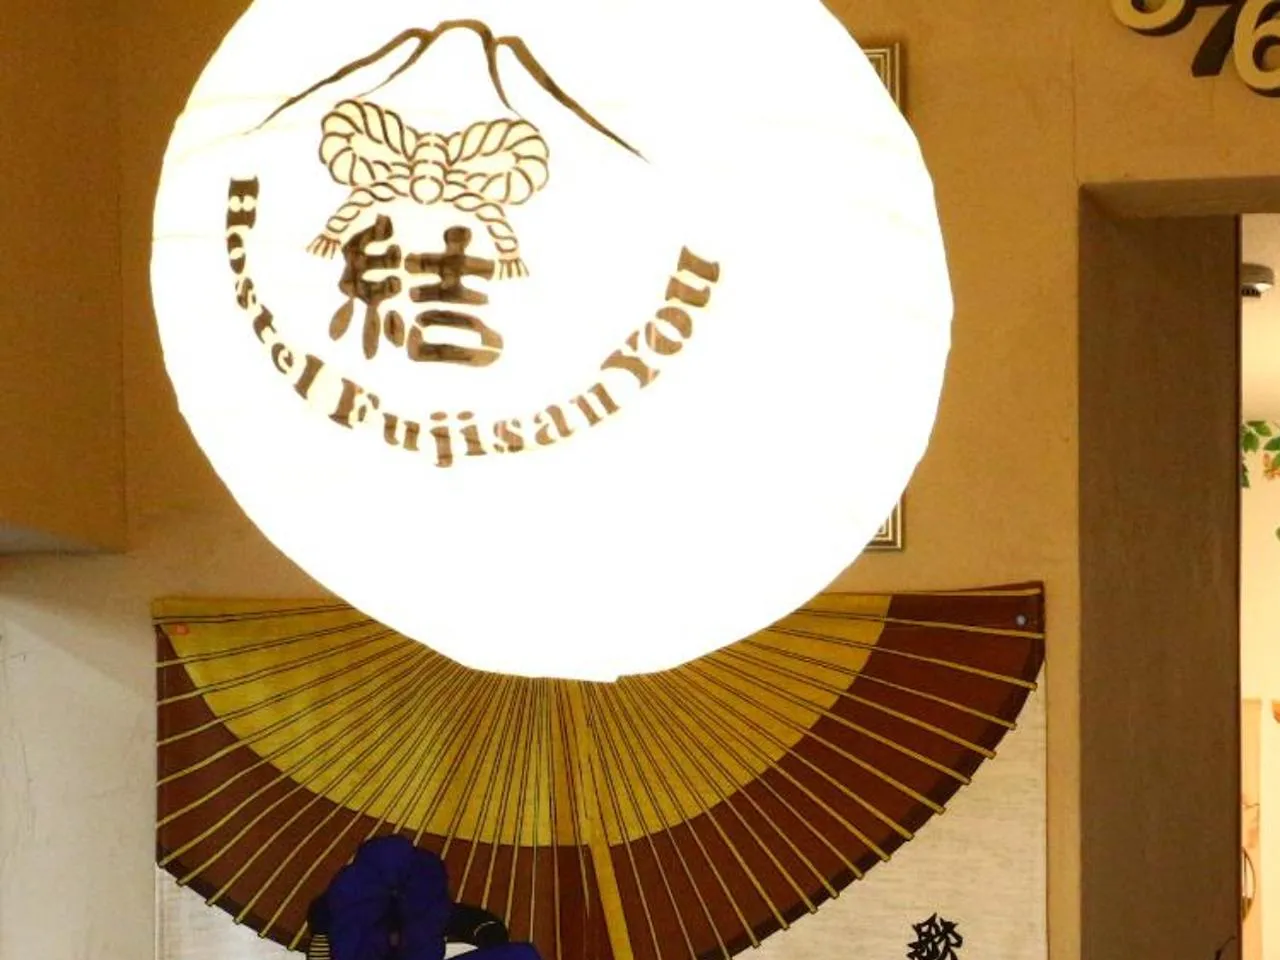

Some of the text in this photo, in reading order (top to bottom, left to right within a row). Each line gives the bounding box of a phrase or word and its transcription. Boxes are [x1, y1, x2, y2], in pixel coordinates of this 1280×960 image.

[225, 175, 325, 399] Hostel
[327, 377, 621, 468] Fujisan
[328, 213, 504, 368] 結
